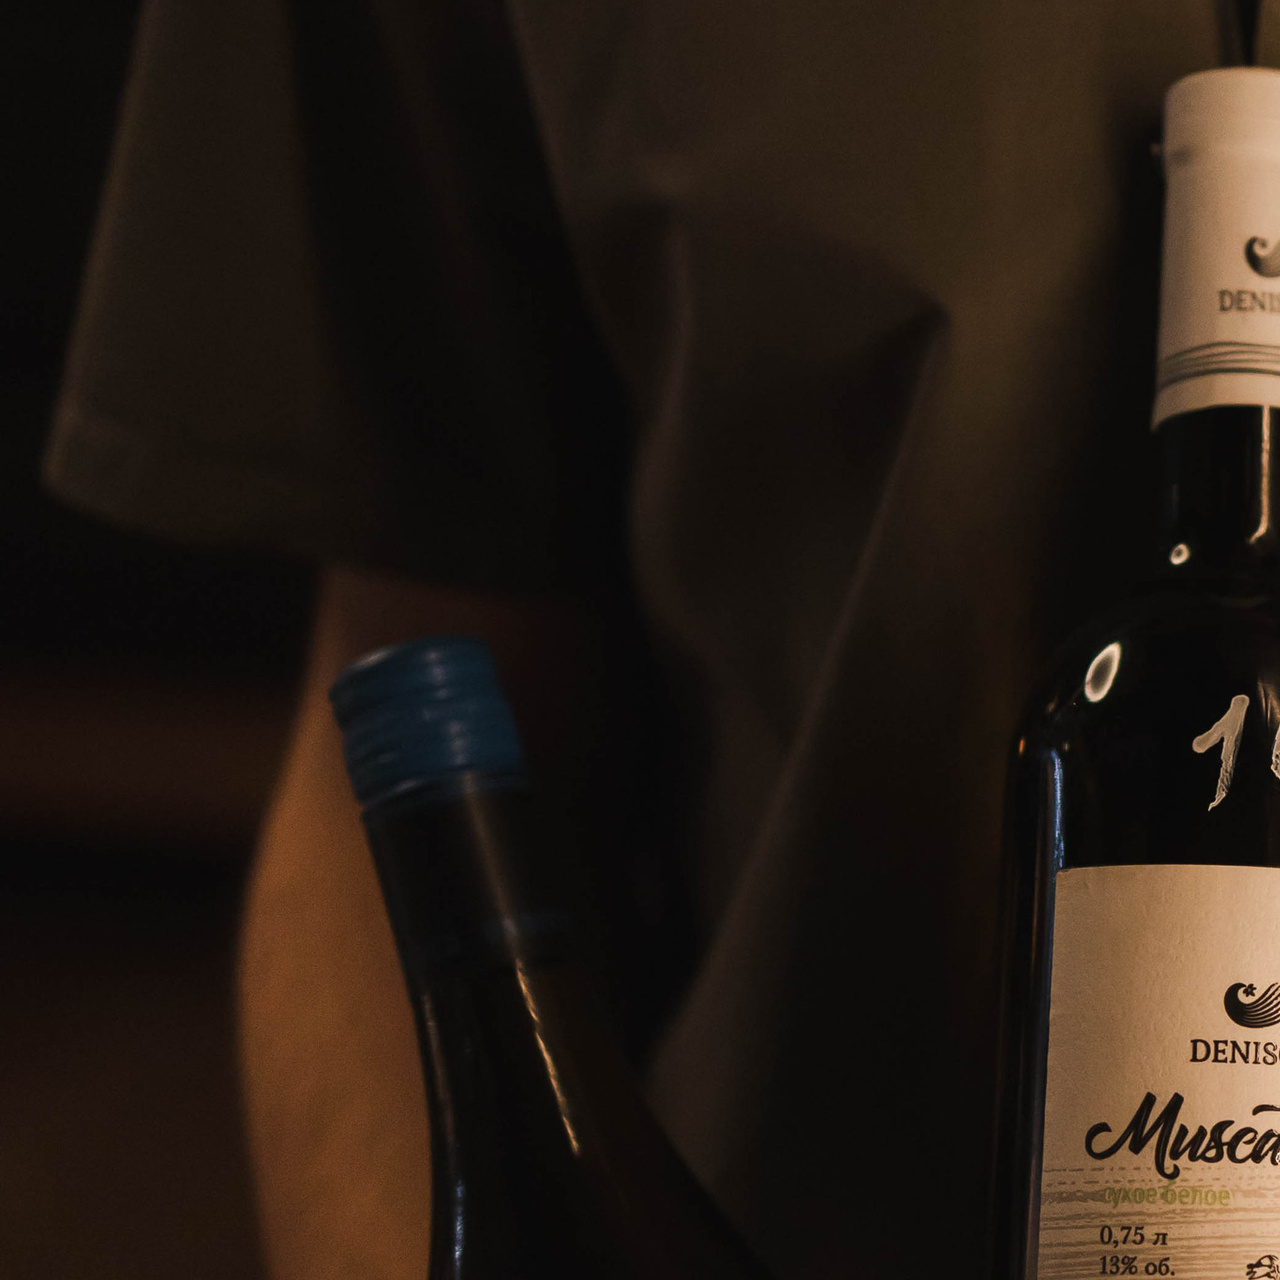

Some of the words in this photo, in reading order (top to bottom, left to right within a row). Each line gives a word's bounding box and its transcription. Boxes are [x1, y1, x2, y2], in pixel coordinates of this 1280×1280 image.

[1103, 1186, 1158, 1210] сухое
[1160, 1179, 1231, 1207] белое
[1100, 1225, 1145, 1248] 0,75
[1152, 1232, 1168, 1246] л
[1100, 1255, 1138, 1276] 13%
[1144, 1257, 1176, 1277] об.
